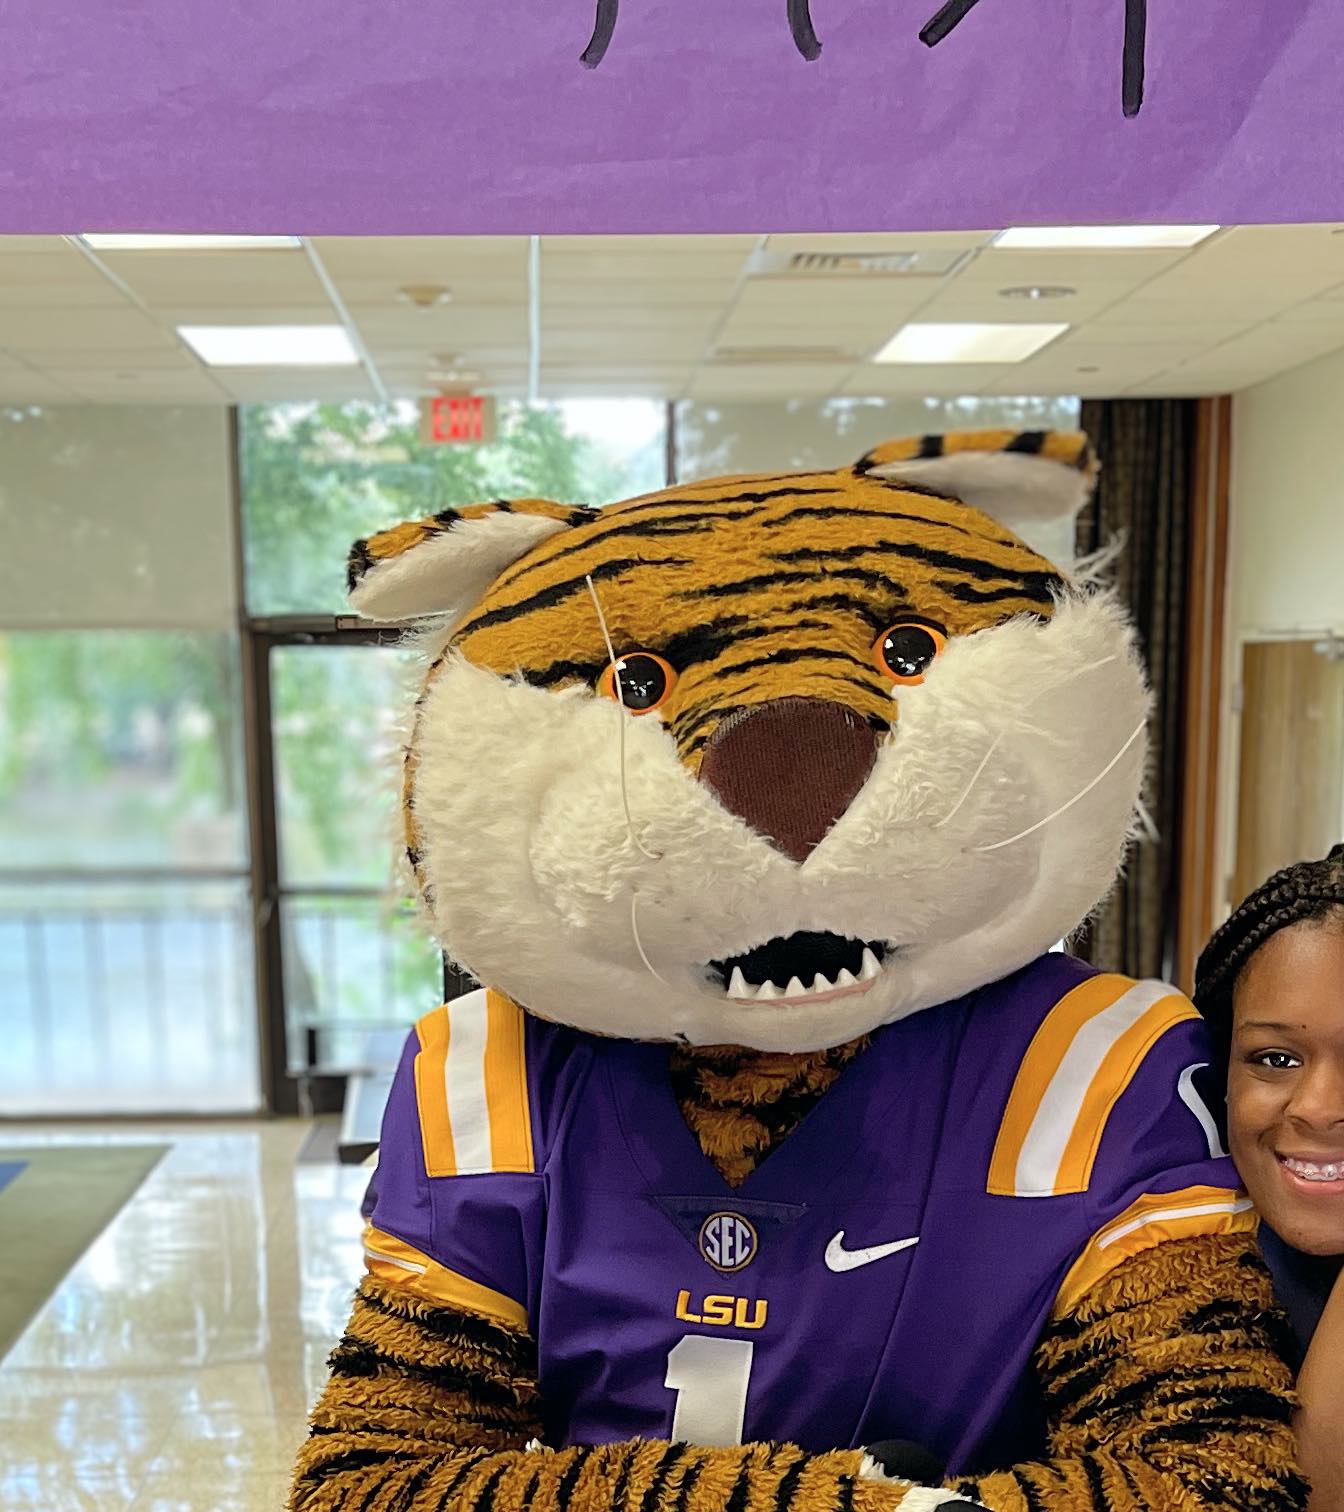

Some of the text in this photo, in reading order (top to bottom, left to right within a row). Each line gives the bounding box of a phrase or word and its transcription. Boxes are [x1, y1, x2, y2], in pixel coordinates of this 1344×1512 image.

[705, 1217, 752, 1267] SEC
[675, 1289, 768, 1329] LSU
[664, 1334, 753, 1449] 1
